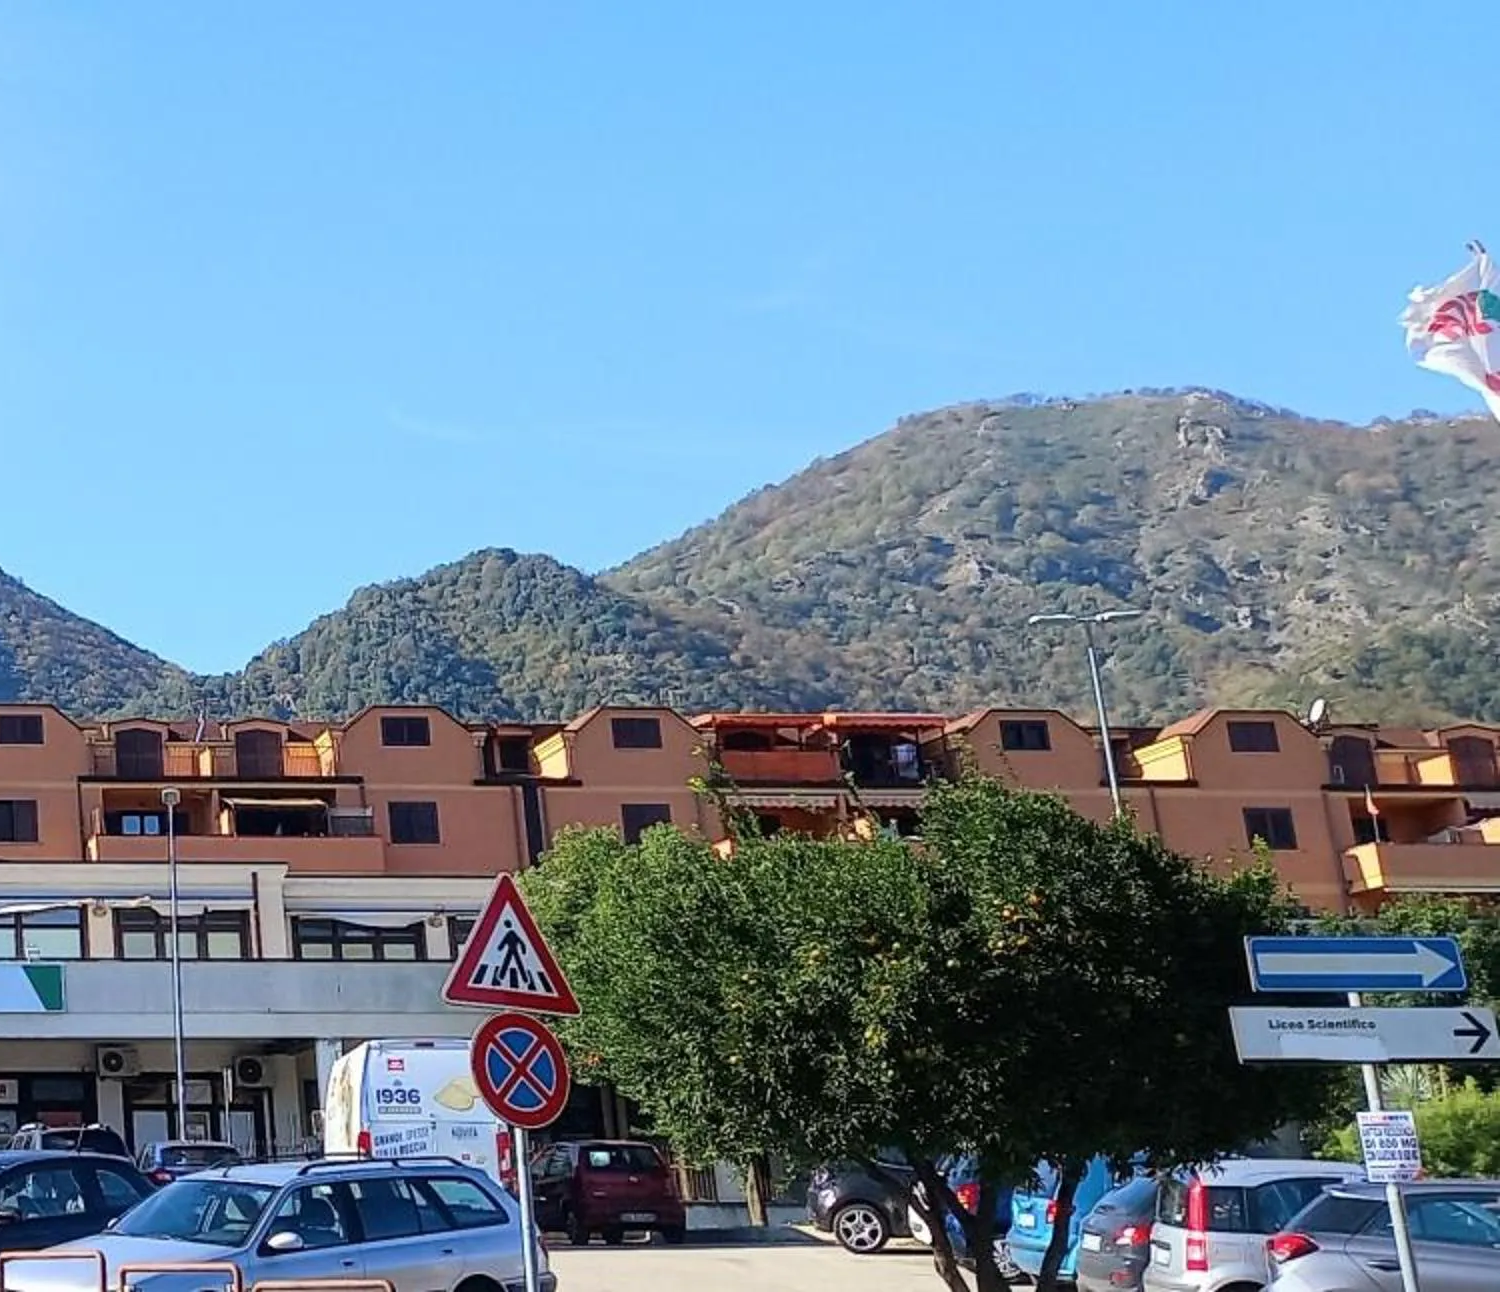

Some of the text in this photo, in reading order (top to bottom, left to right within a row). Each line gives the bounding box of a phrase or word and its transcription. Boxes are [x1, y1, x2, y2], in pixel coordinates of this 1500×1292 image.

[1267, 1018, 1377, 1030] Liceo Scientifico
[375, 1087, 421, 1105] 1936
